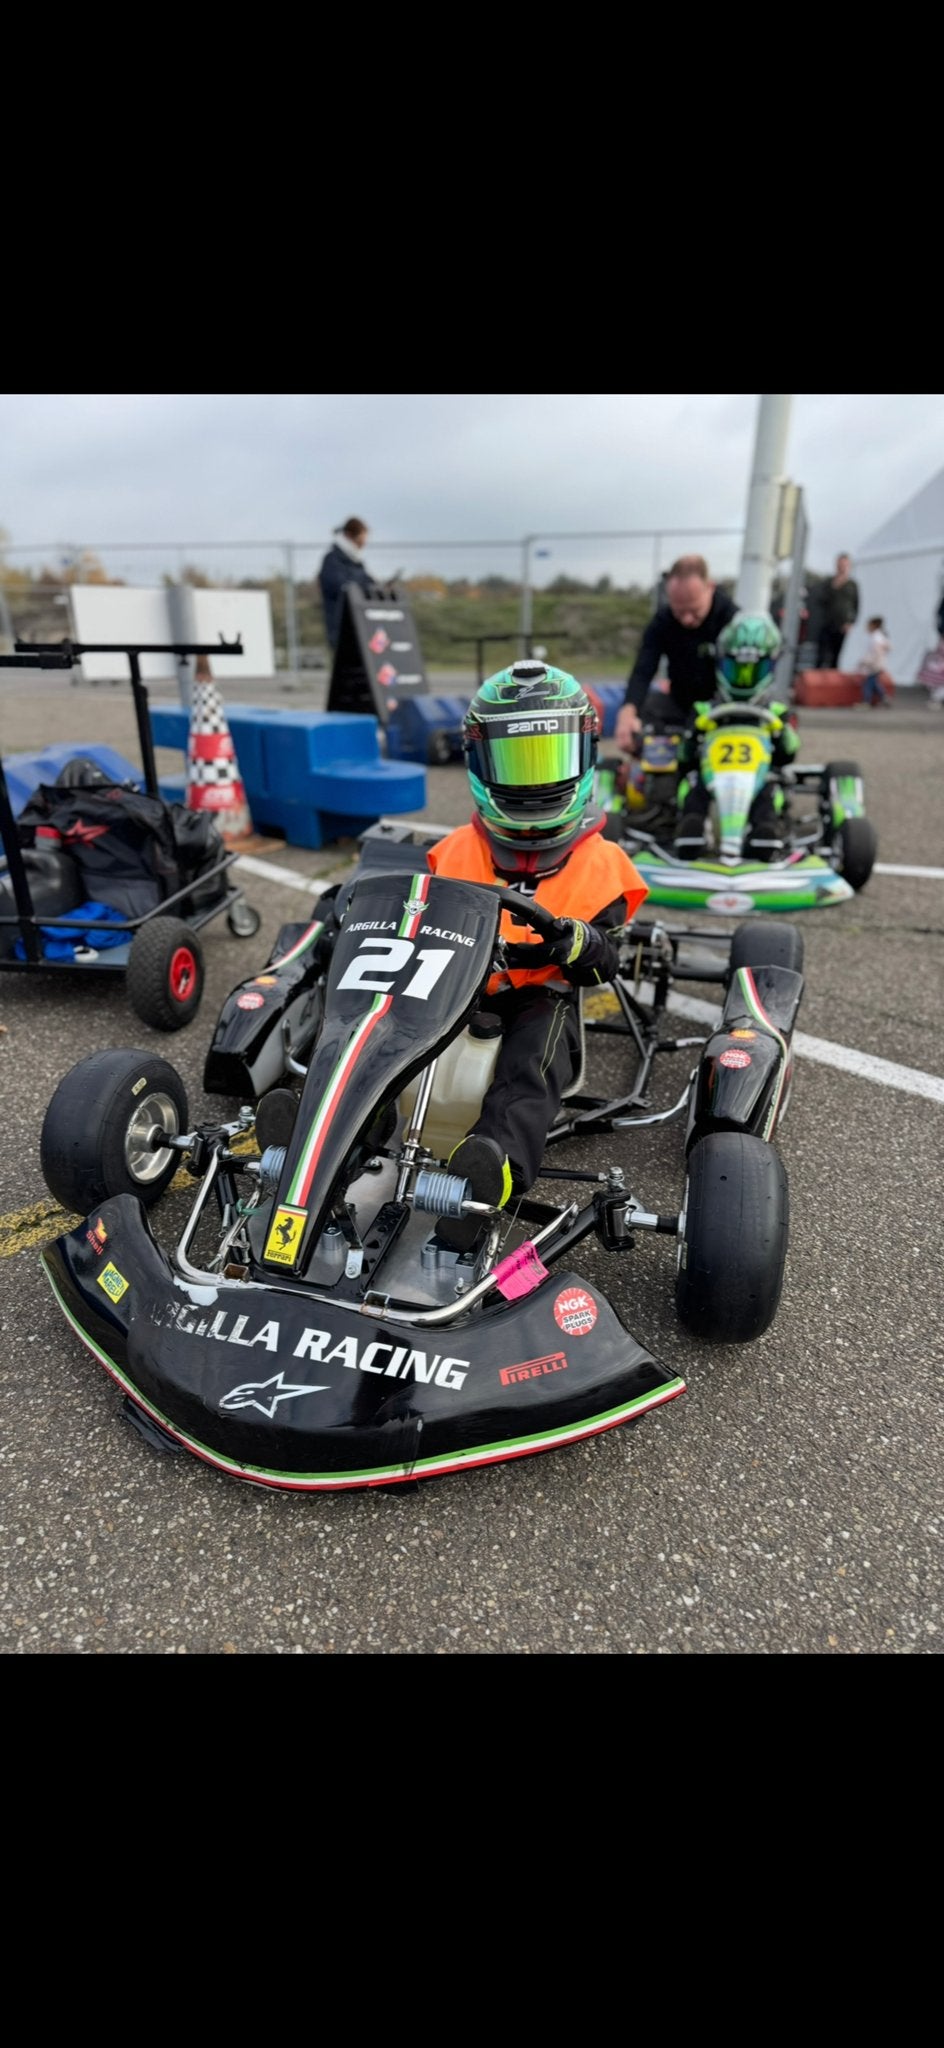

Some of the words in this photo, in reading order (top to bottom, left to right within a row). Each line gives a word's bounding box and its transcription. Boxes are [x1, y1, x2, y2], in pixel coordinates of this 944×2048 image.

[507, 720, 558, 734] zamp
[720, 744, 752, 764] 23
[346, 921, 397, 933] ARGILLA
[420, 925, 476, 948] RACING
[336, 937, 456, 1001] 21
[86, 1230, 103, 1255] Shell
[266, 1249, 291, 1262] Ferrari
[558, 1296, 588, 1313] NGK
[563, 1310, 591, 1323] SPARK
[565, 1318, 593, 1329] PLUGS
[293, 1328, 471, 1391] RACING
[499, 1352, 568, 1386] PIRELLI
